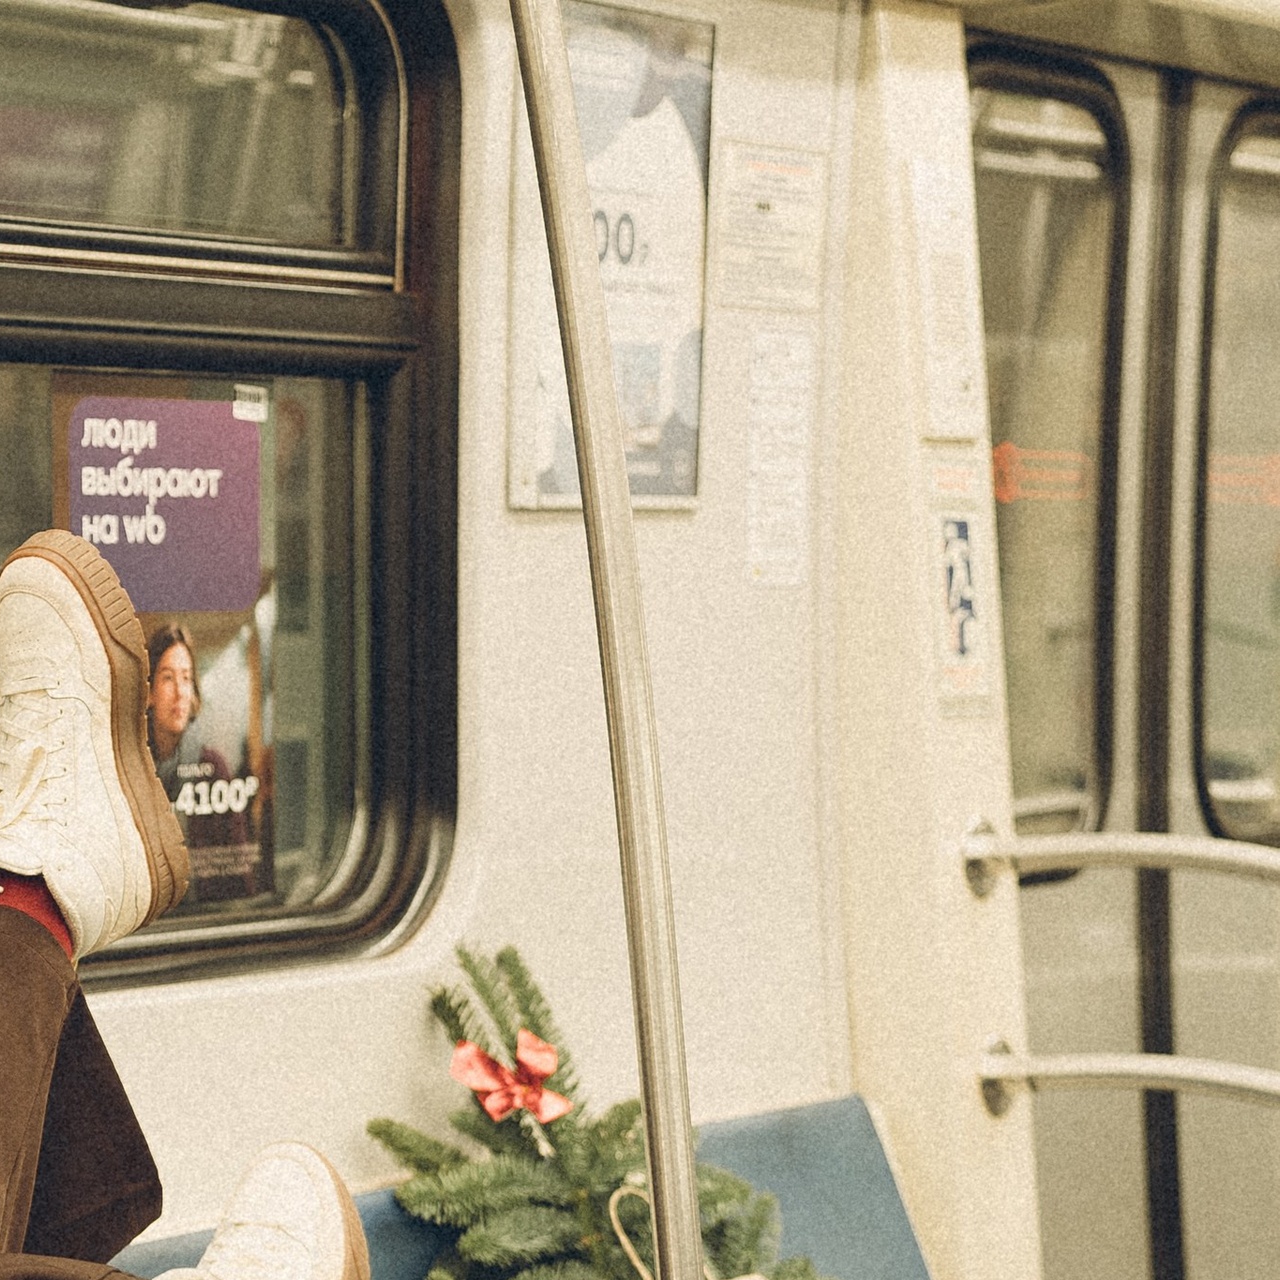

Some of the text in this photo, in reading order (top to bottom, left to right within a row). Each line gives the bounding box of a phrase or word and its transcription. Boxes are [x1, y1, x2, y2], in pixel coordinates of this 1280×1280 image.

[81, 418, 157, 455] люди
[81, 455, 223, 506] выбирают
[82, 504, 167, 545] на wb
